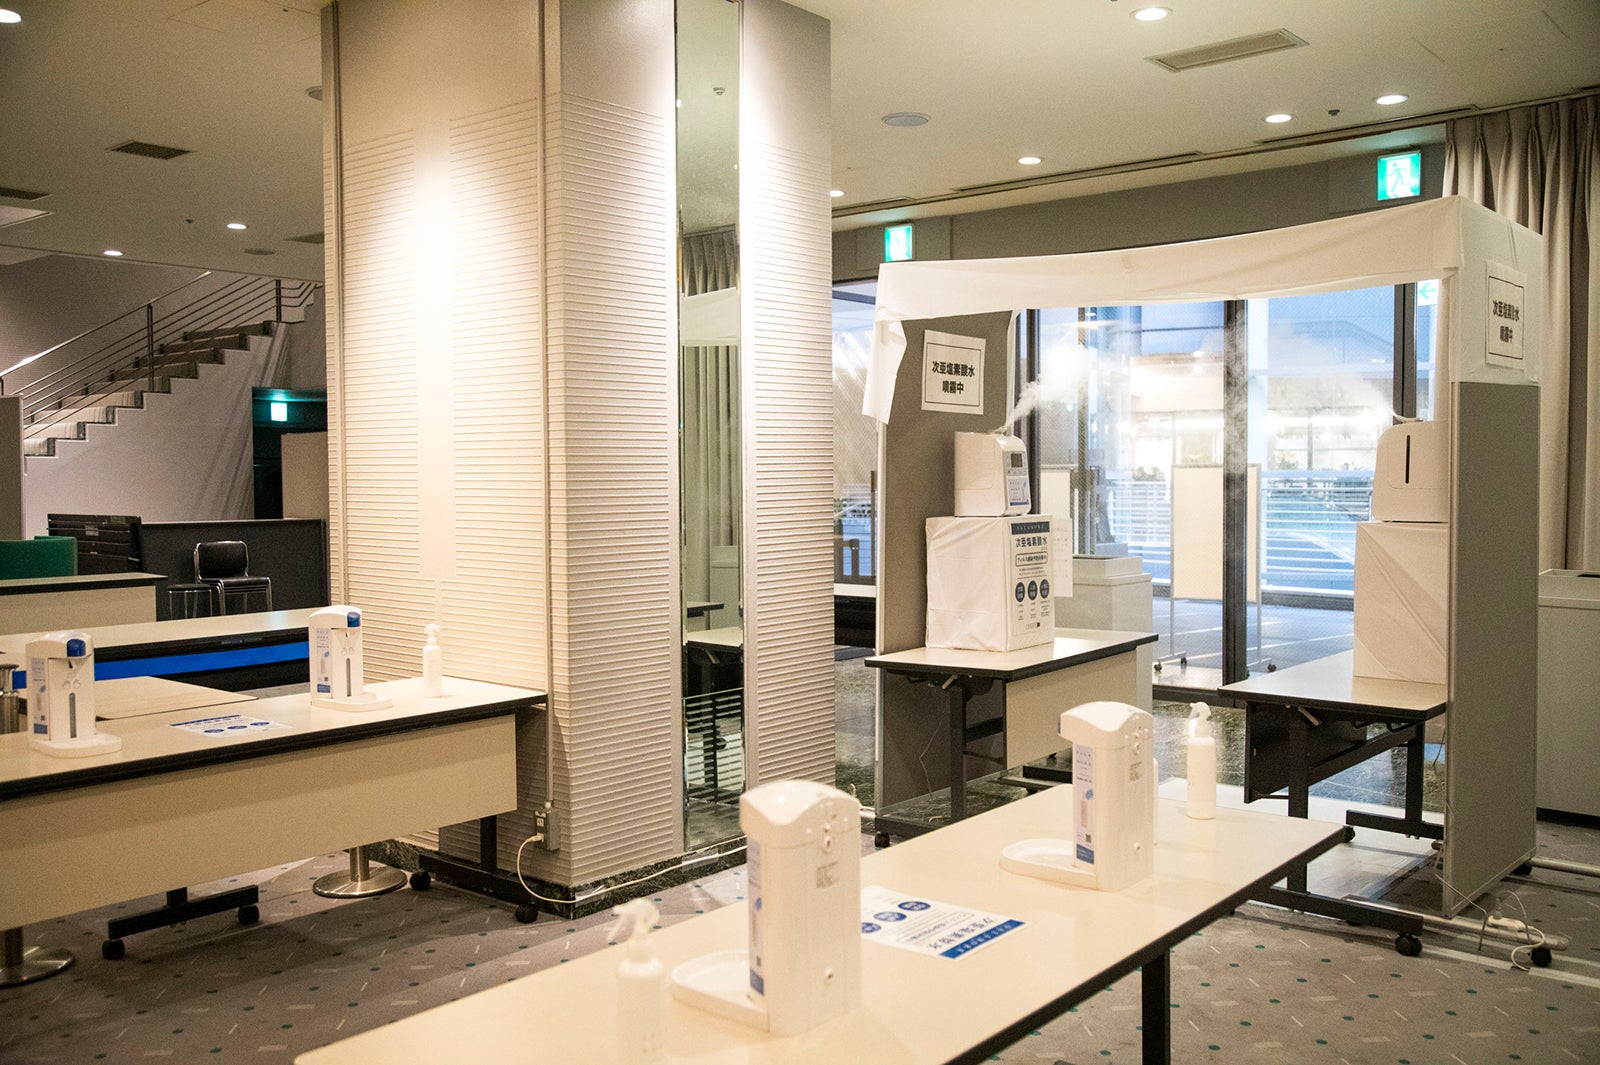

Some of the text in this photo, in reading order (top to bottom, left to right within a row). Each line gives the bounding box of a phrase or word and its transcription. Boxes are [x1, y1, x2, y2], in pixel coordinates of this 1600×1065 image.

[1493, 300, 1519, 321] 次亜塩素酸水
[932, 361, 975, 377] 次亜塩素酸水
[942, 380, 964, 394] 噴霧中
[1015, 536, 1047, 547] 次亜塩素酸水
